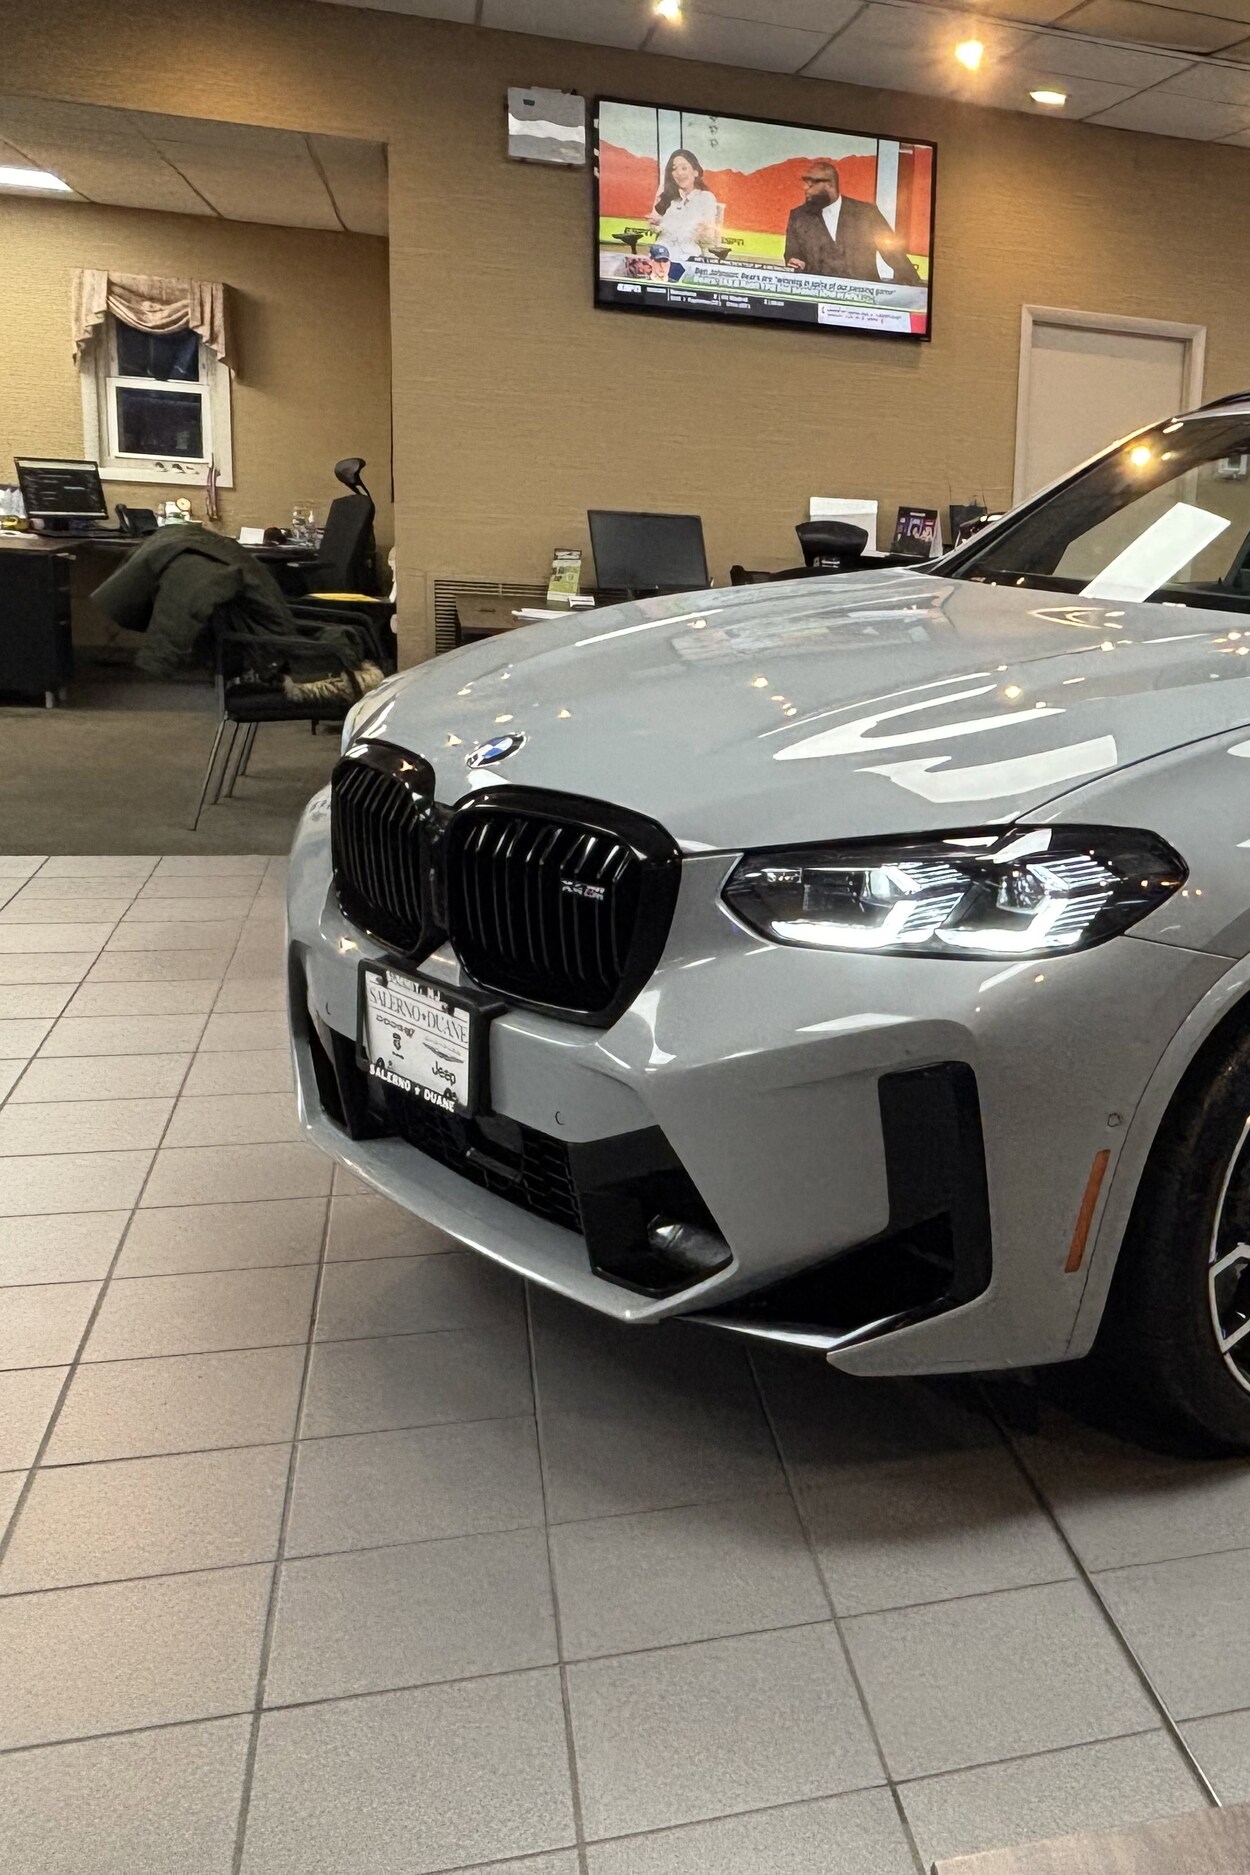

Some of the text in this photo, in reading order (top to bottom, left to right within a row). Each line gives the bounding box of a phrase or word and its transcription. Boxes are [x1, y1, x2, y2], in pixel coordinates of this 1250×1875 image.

[369, 986, 468, 1043] SALERNO DUANE
[369, 1063, 456, 1113] SALERNO DUANE
[431, 1061, 456, 1086] Jeep
